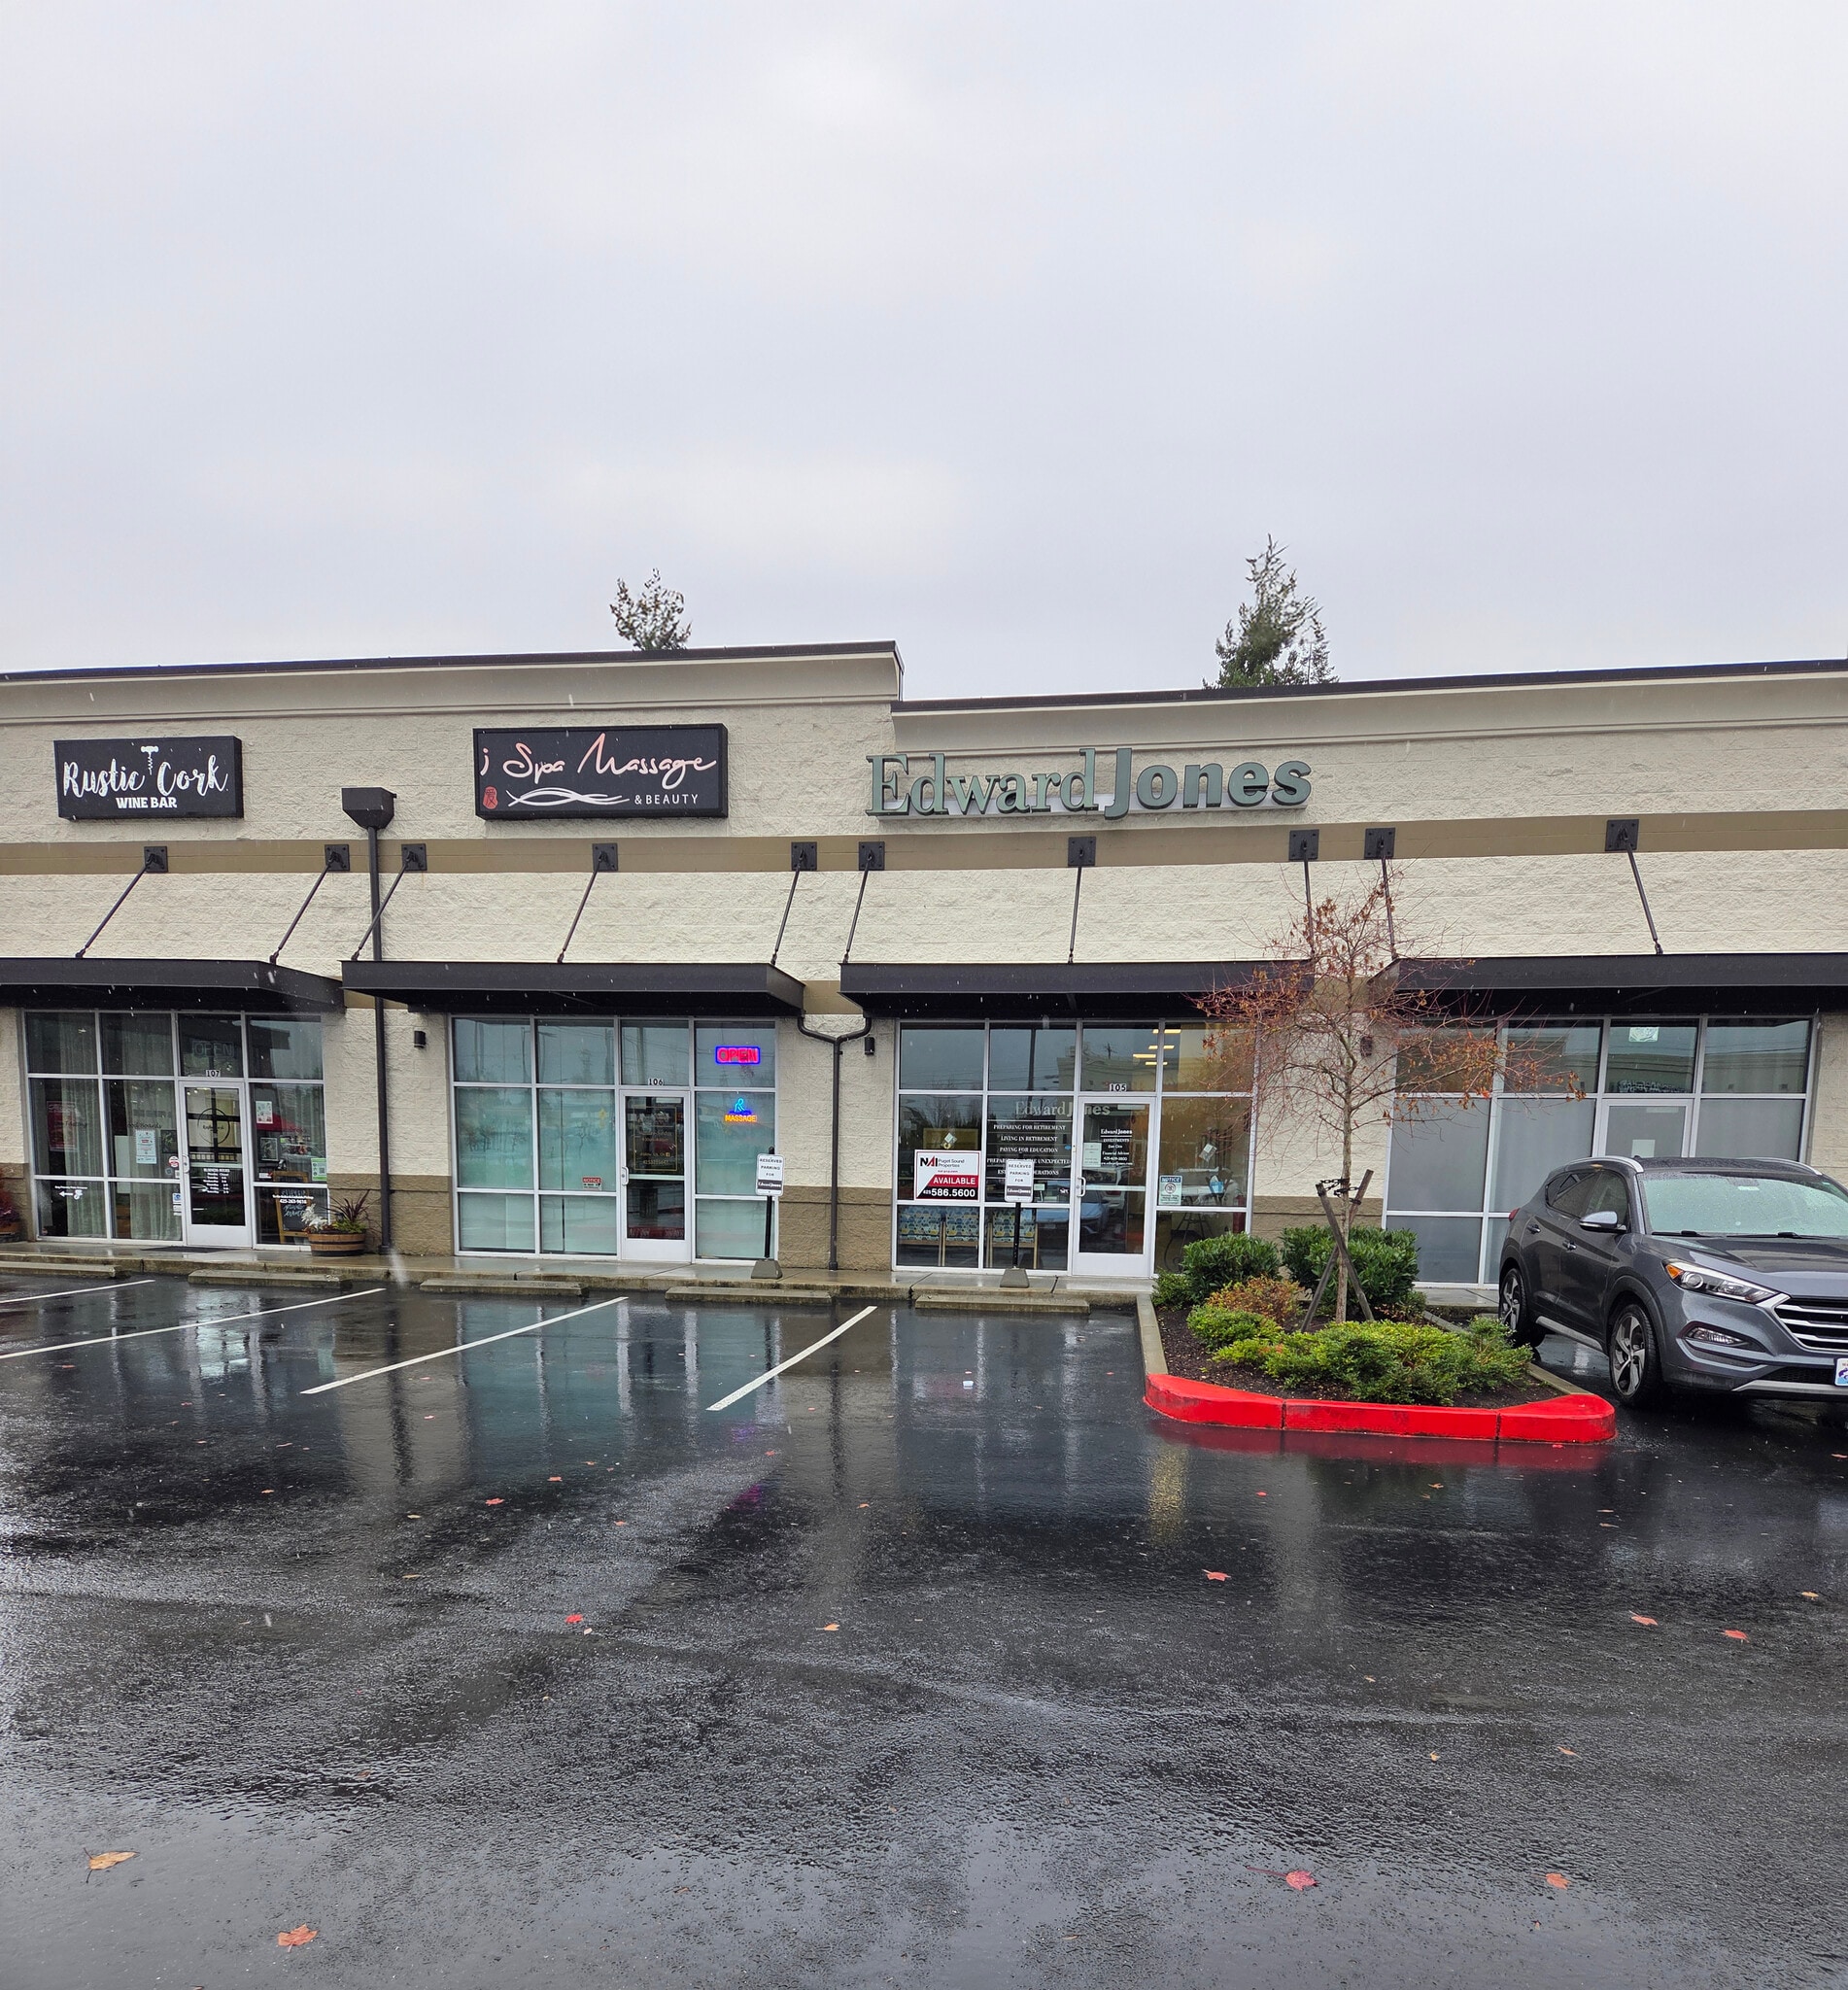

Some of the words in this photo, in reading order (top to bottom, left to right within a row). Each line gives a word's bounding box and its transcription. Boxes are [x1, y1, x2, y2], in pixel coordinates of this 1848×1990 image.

[502, 742, 565, 784] Spa
[577, 733, 717, 789] Massage
[63, 758, 146, 798] Rustic
[156, 754, 229, 797] Cork
[865, 747, 1099, 817] Edward
[1104, 747, 1313, 820] Jones
[116, 797, 148, 808] WINE
[151, 797, 177, 808] BAR
[634, 795, 642, 805] &
[646, 794, 699, 805] BEAUTY
[717, 1047, 759, 1063] OPEN
[649, 1078, 664, 1086] 106
[1110, 1083, 1126, 1092] 105
[1015, 1100, 1066, 1115] Edward
[1067, 1101, 1111, 1117] Jnes
[920, 1155, 939, 1167] NAI
[931, 1187, 975, 1197] 586.5600
